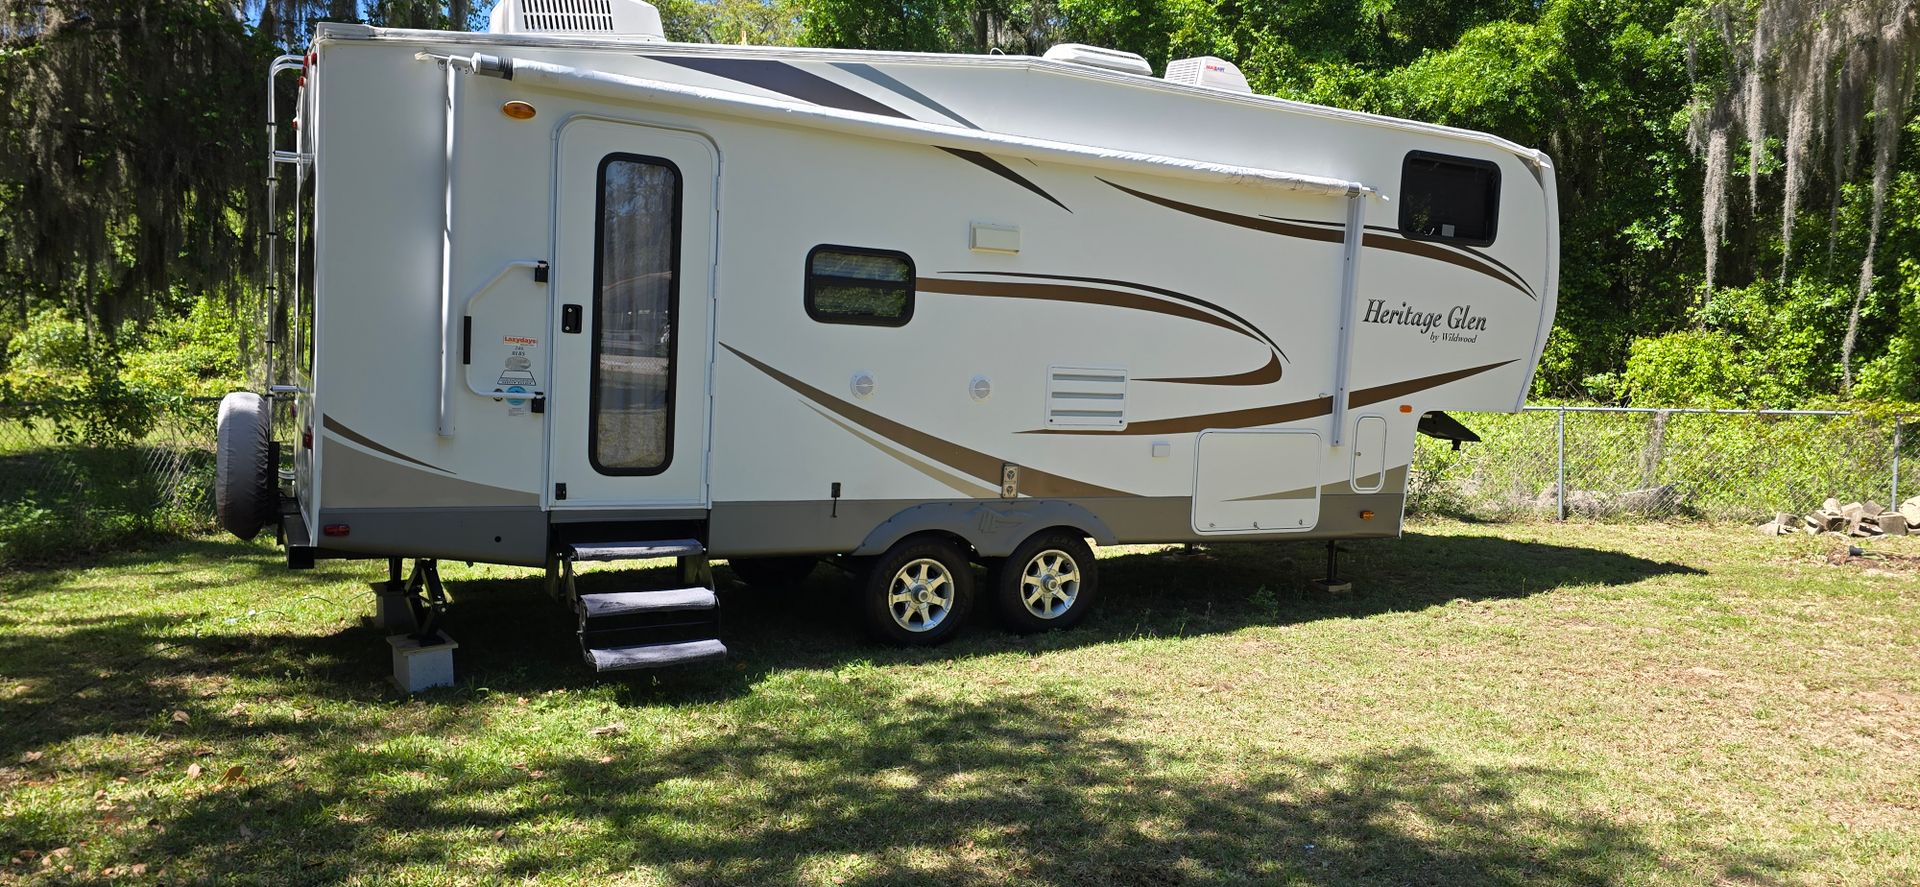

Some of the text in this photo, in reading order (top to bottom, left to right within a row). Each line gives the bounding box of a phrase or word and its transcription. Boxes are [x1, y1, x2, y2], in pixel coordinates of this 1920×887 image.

[1362, 299, 1487, 334] Heritage Glen
[1430, 332, 1478, 343] by Wildwood
